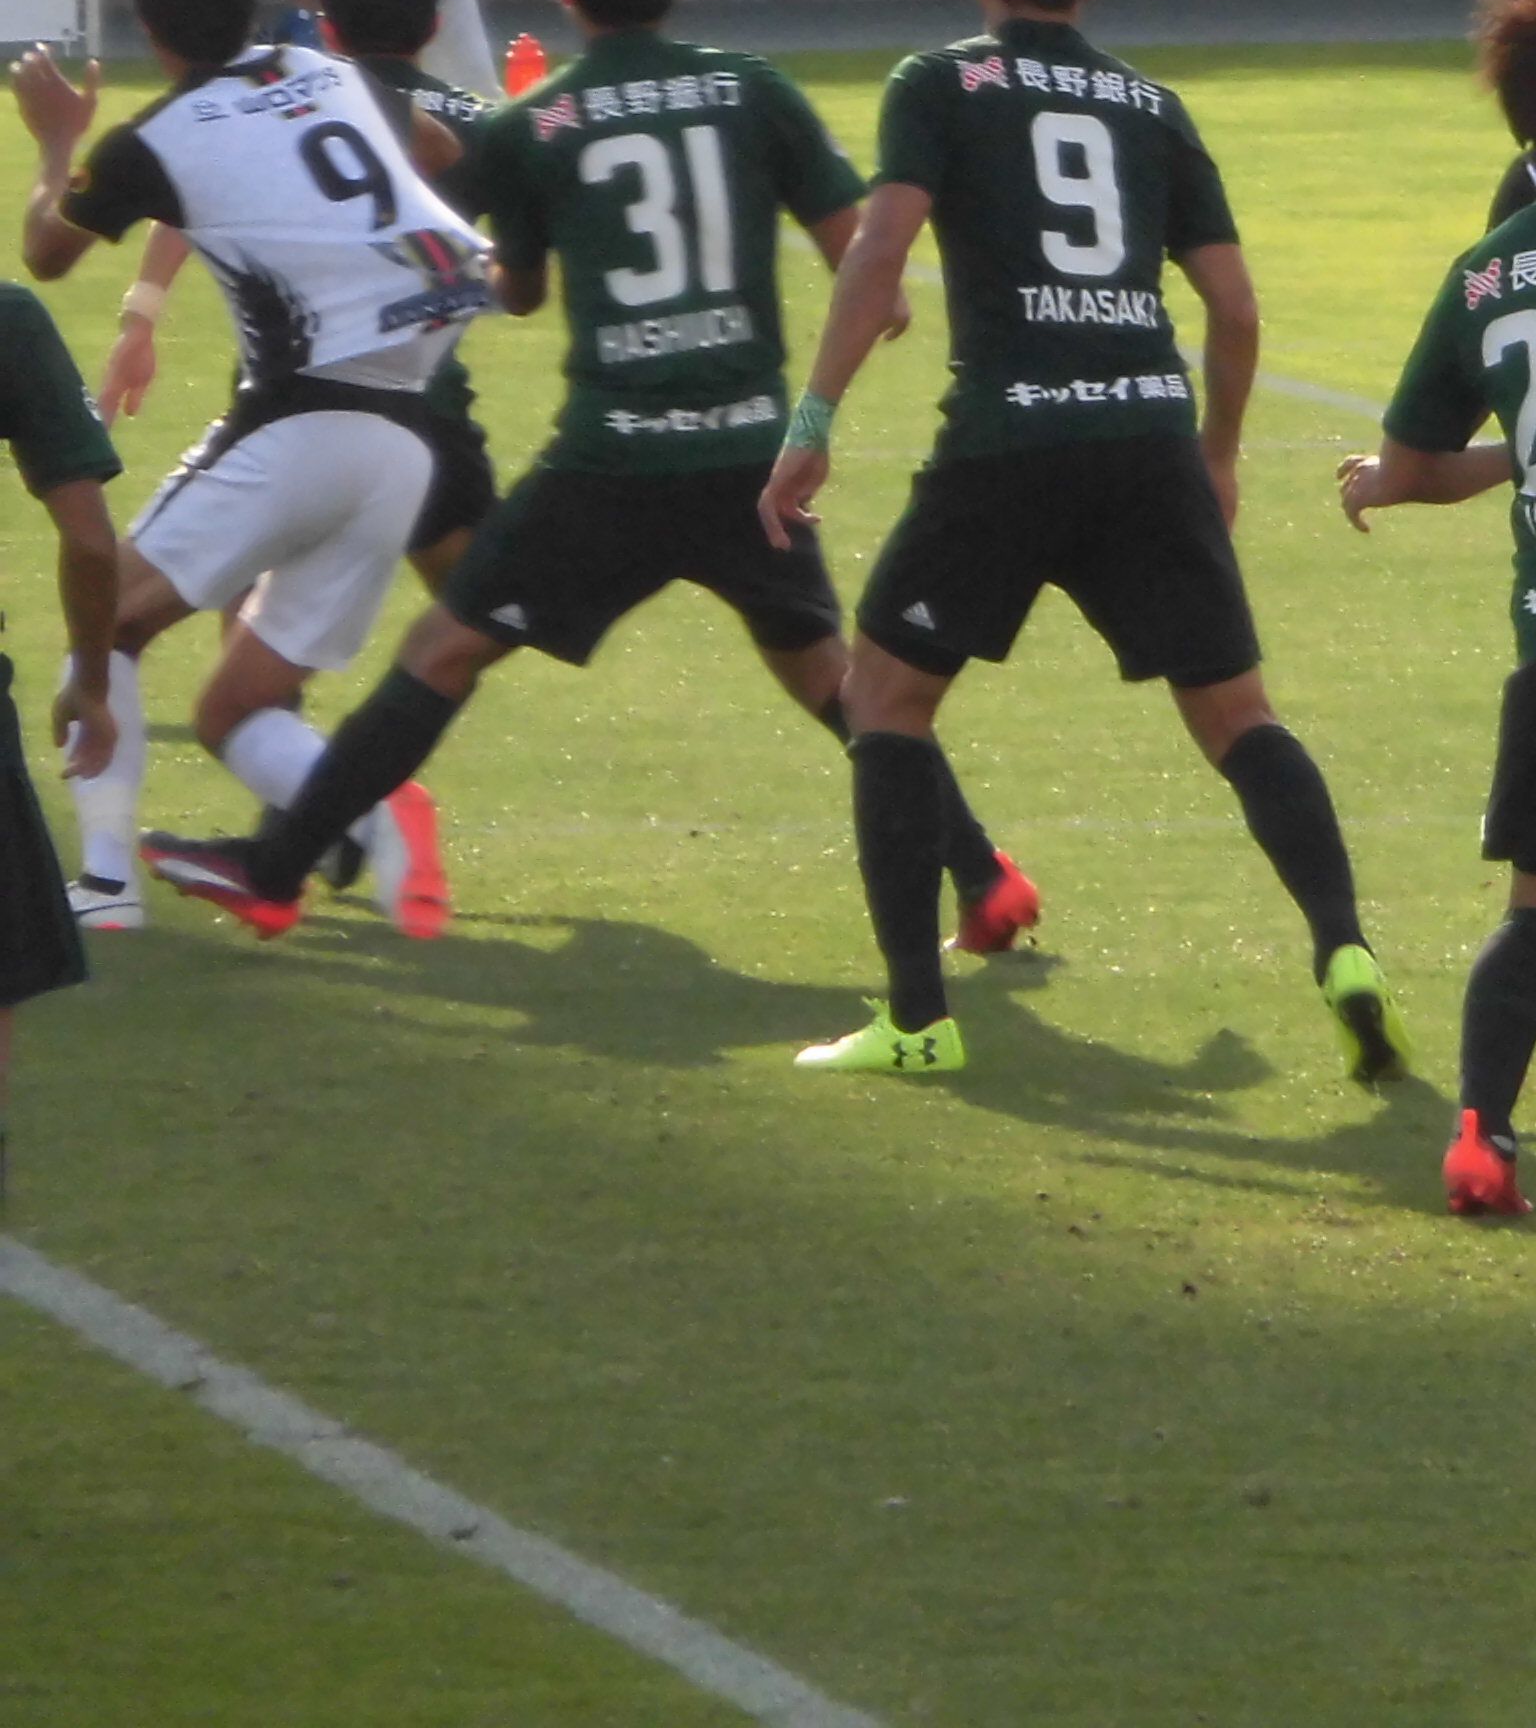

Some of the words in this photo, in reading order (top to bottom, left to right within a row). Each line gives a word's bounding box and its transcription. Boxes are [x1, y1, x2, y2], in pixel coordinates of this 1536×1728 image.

[1016, 57, 1163, 115] 長野銀行
[298, 120, 396, 229] 9
[578, 125, 736, 306] 31
[1030, 112, 1126, 275] 9
[1017, 286, 1158, 326] TAKASAKI
[1005, 374, 1188, 407] キッセイ薬品
